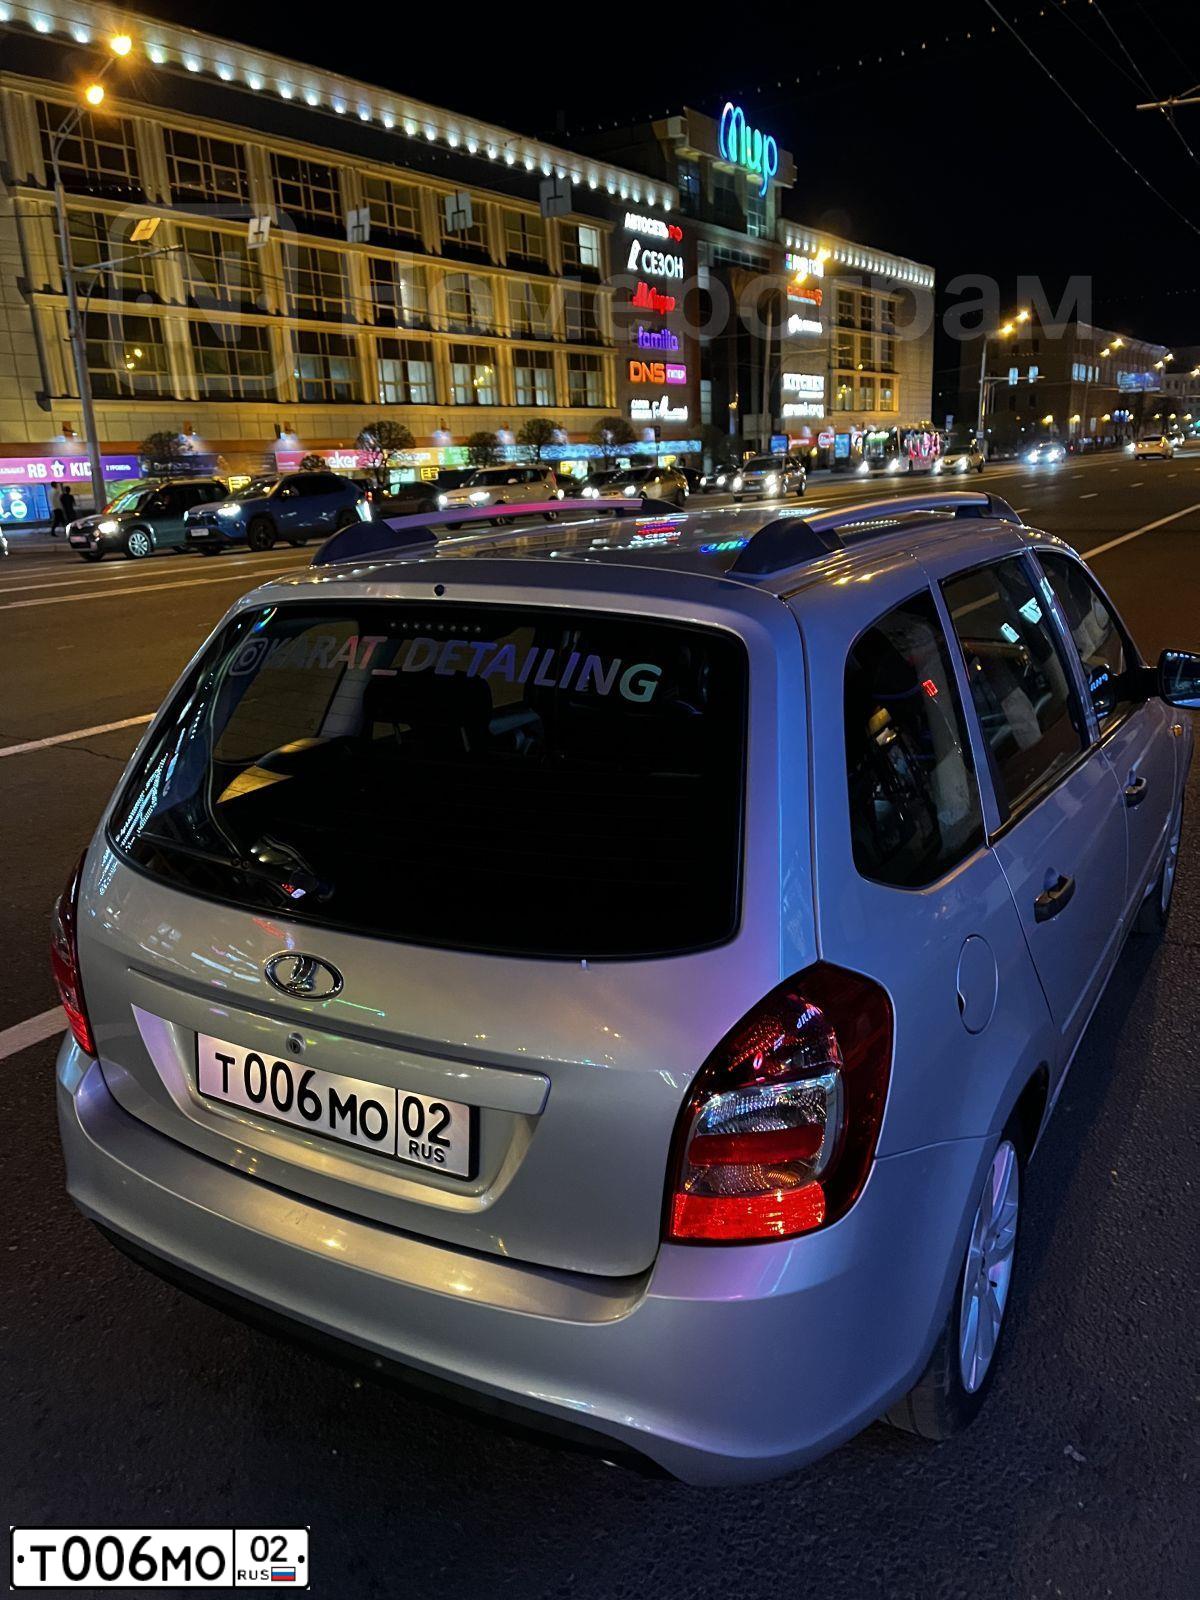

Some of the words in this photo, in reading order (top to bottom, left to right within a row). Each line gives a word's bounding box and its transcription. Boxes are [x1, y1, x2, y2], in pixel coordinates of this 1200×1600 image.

[641, 250, 684, 279] СЕЗОН
[638, 325, 679, 351] familia
[629, 361, 666, 384] DNS
[27, 463, 48, 478] RB
[70, 462, 92, 477] KID
[325, 451, 360, 468] eker
[215, 1052, 388, 1141] Т006МО
[402, 1096, 451, 1148] 02
[408, 1139, 445, 1163] RUS
